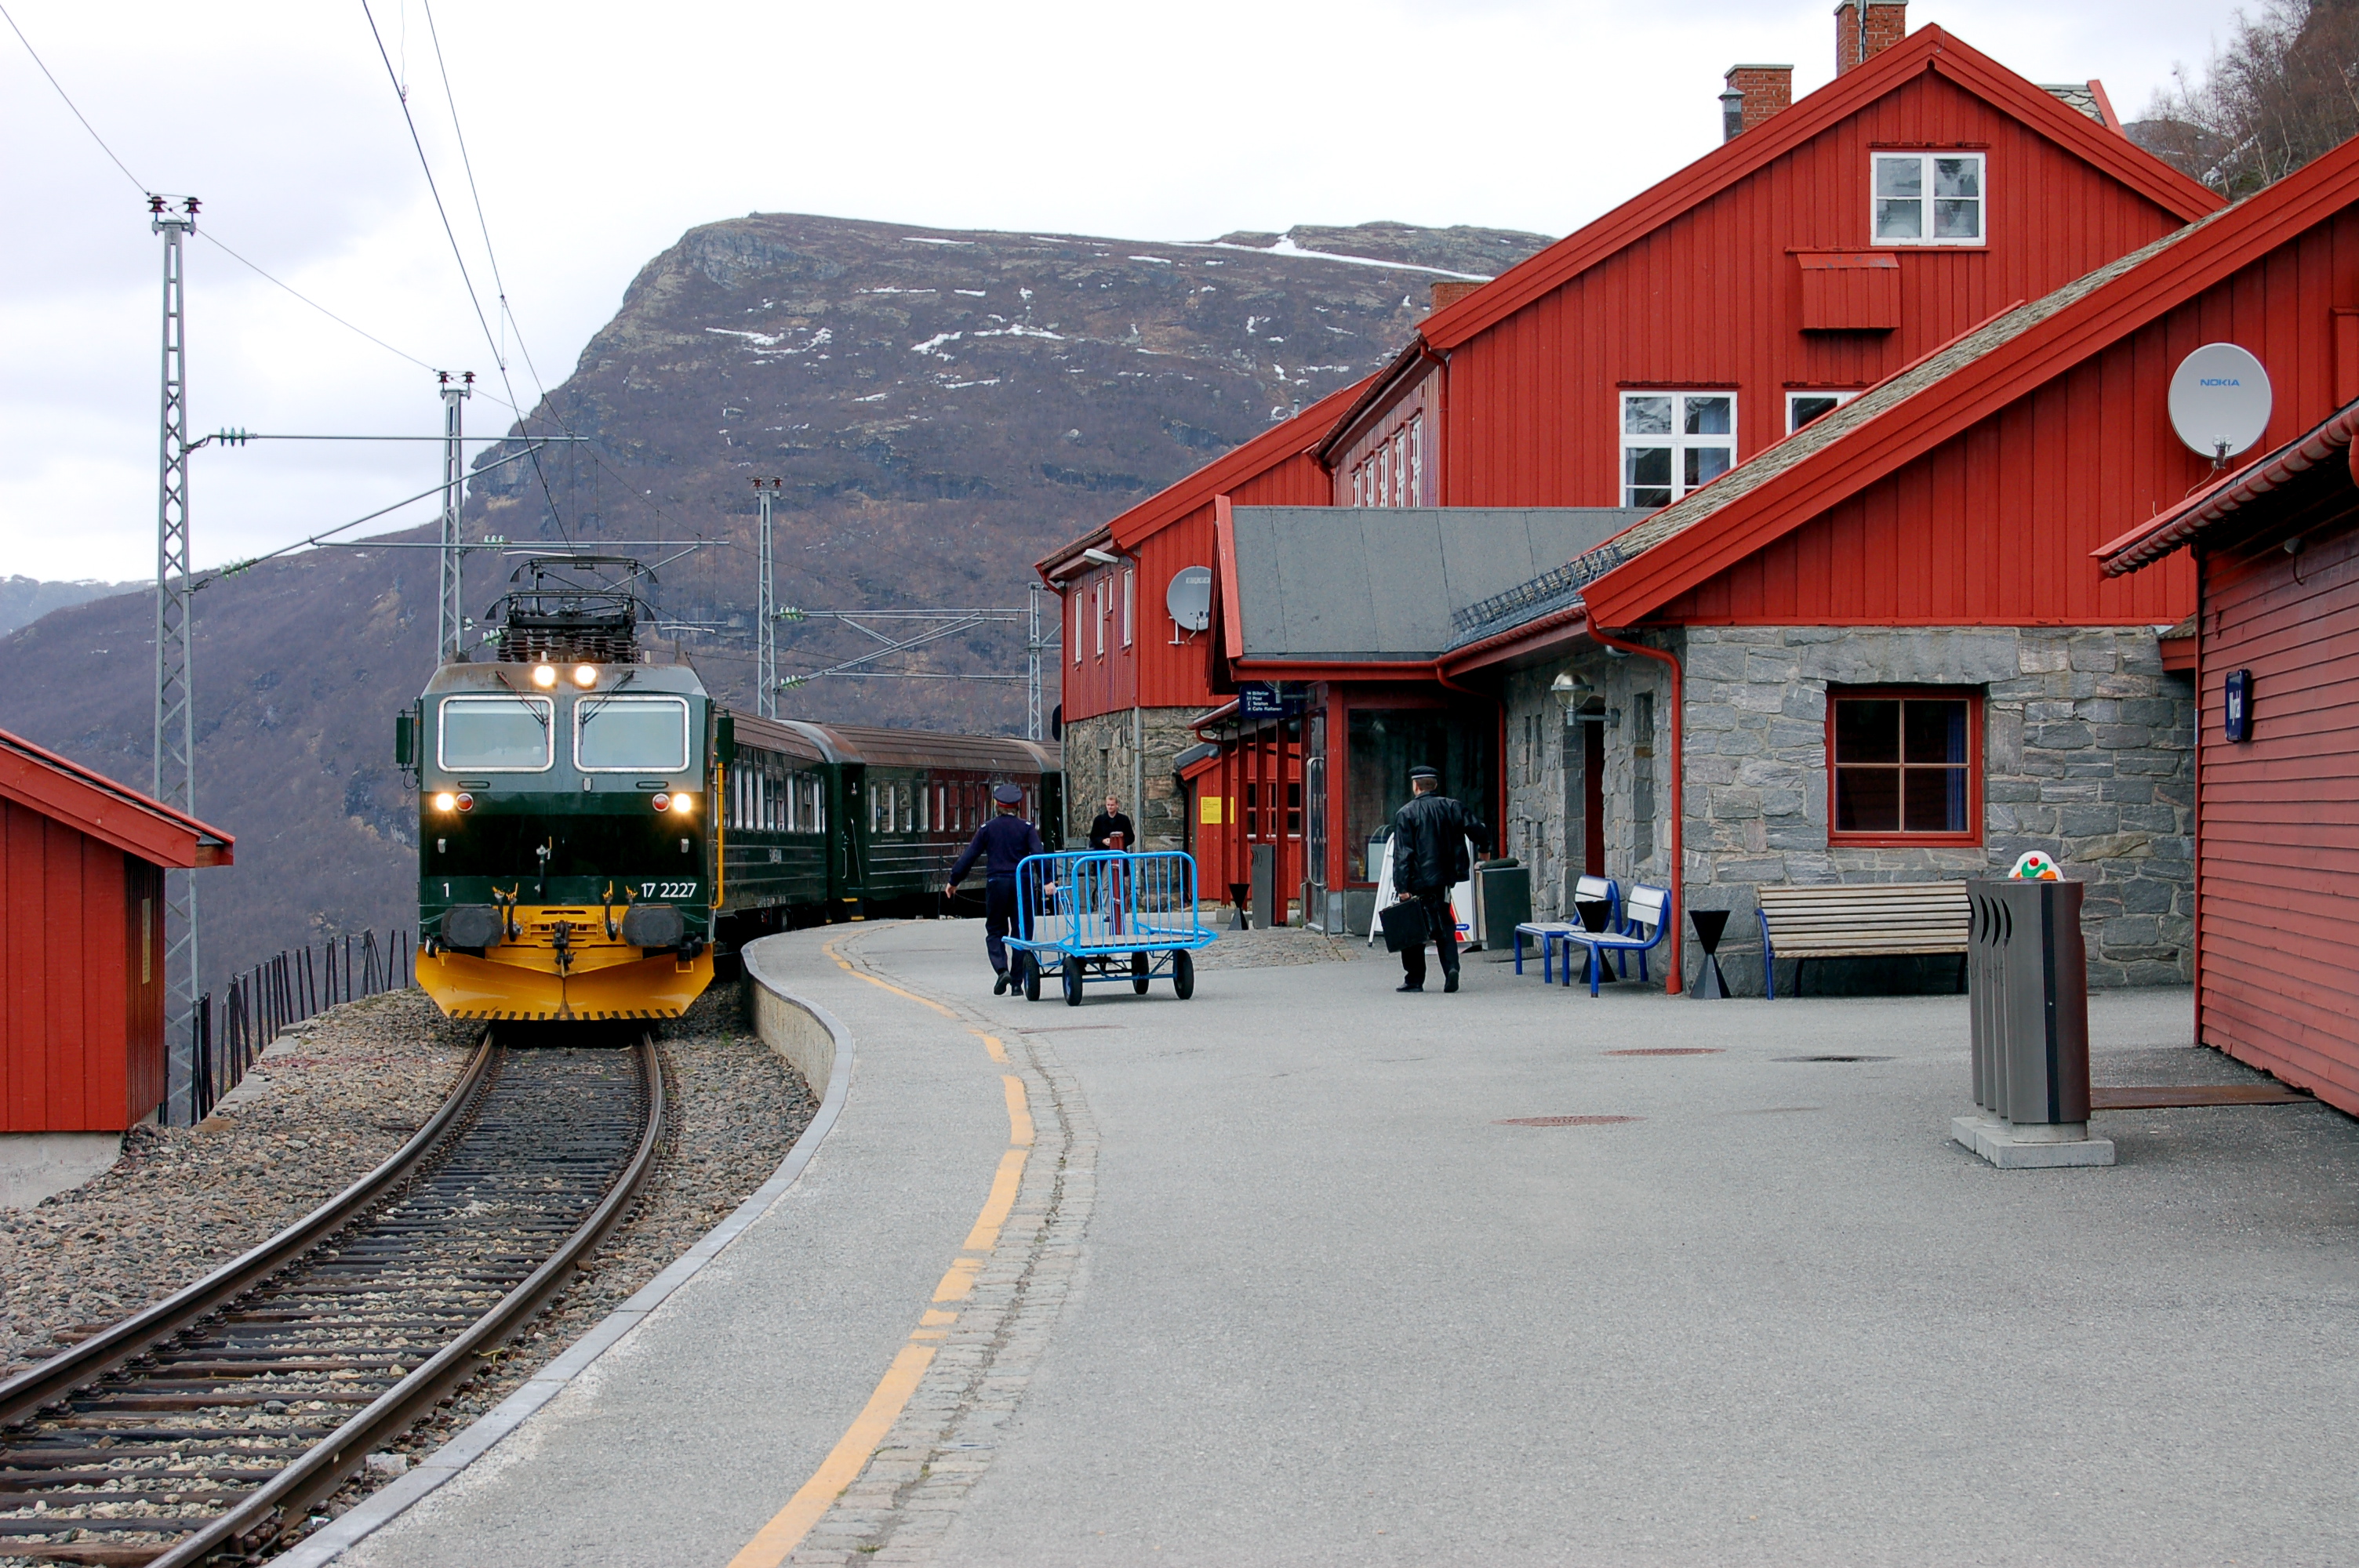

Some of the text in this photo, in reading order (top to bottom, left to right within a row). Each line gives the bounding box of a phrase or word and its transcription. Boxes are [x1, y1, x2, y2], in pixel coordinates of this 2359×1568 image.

[443, 882, 449, 898] 1
[641, 882, 697, 898] 17 2227
